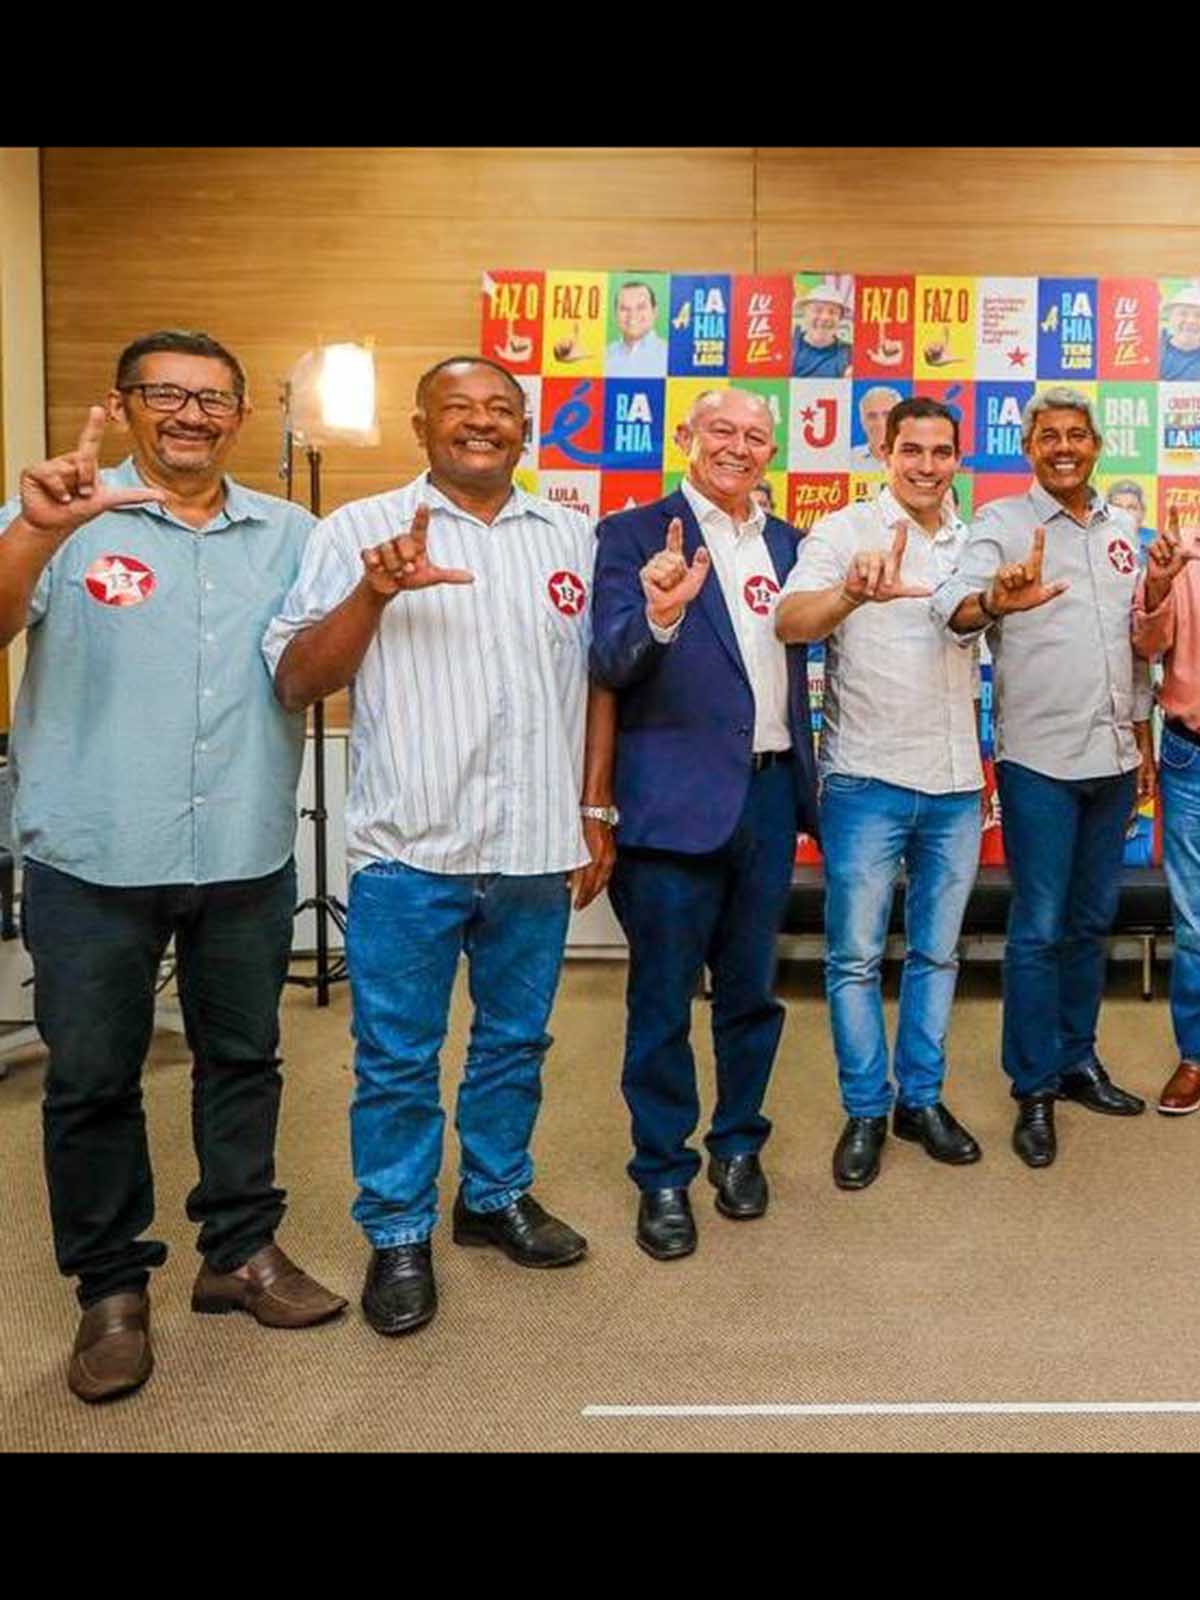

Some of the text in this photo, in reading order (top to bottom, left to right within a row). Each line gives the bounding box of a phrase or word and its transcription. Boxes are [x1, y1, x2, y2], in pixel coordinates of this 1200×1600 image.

[491, 283, 539, 320] FAZ O
[553, 285, 600, 320] FAZ O
[862, 288, 908, 323] FAZ O
[923, 289, 950, 323] FAZ
[958, 289, 969, 323] O
[694, 314, 725, 338] HIA
[1062, 317, 1092, 342] HIA
[615, 392, 653, 422] BA
[986, 397, 1021, 425] BA
[1104, 398, 1151, 425] BRA
[803, 398, 837, 448] J
[1104, 428, 1140, 458] SIL
[548, 488, 580, 502] LULA
